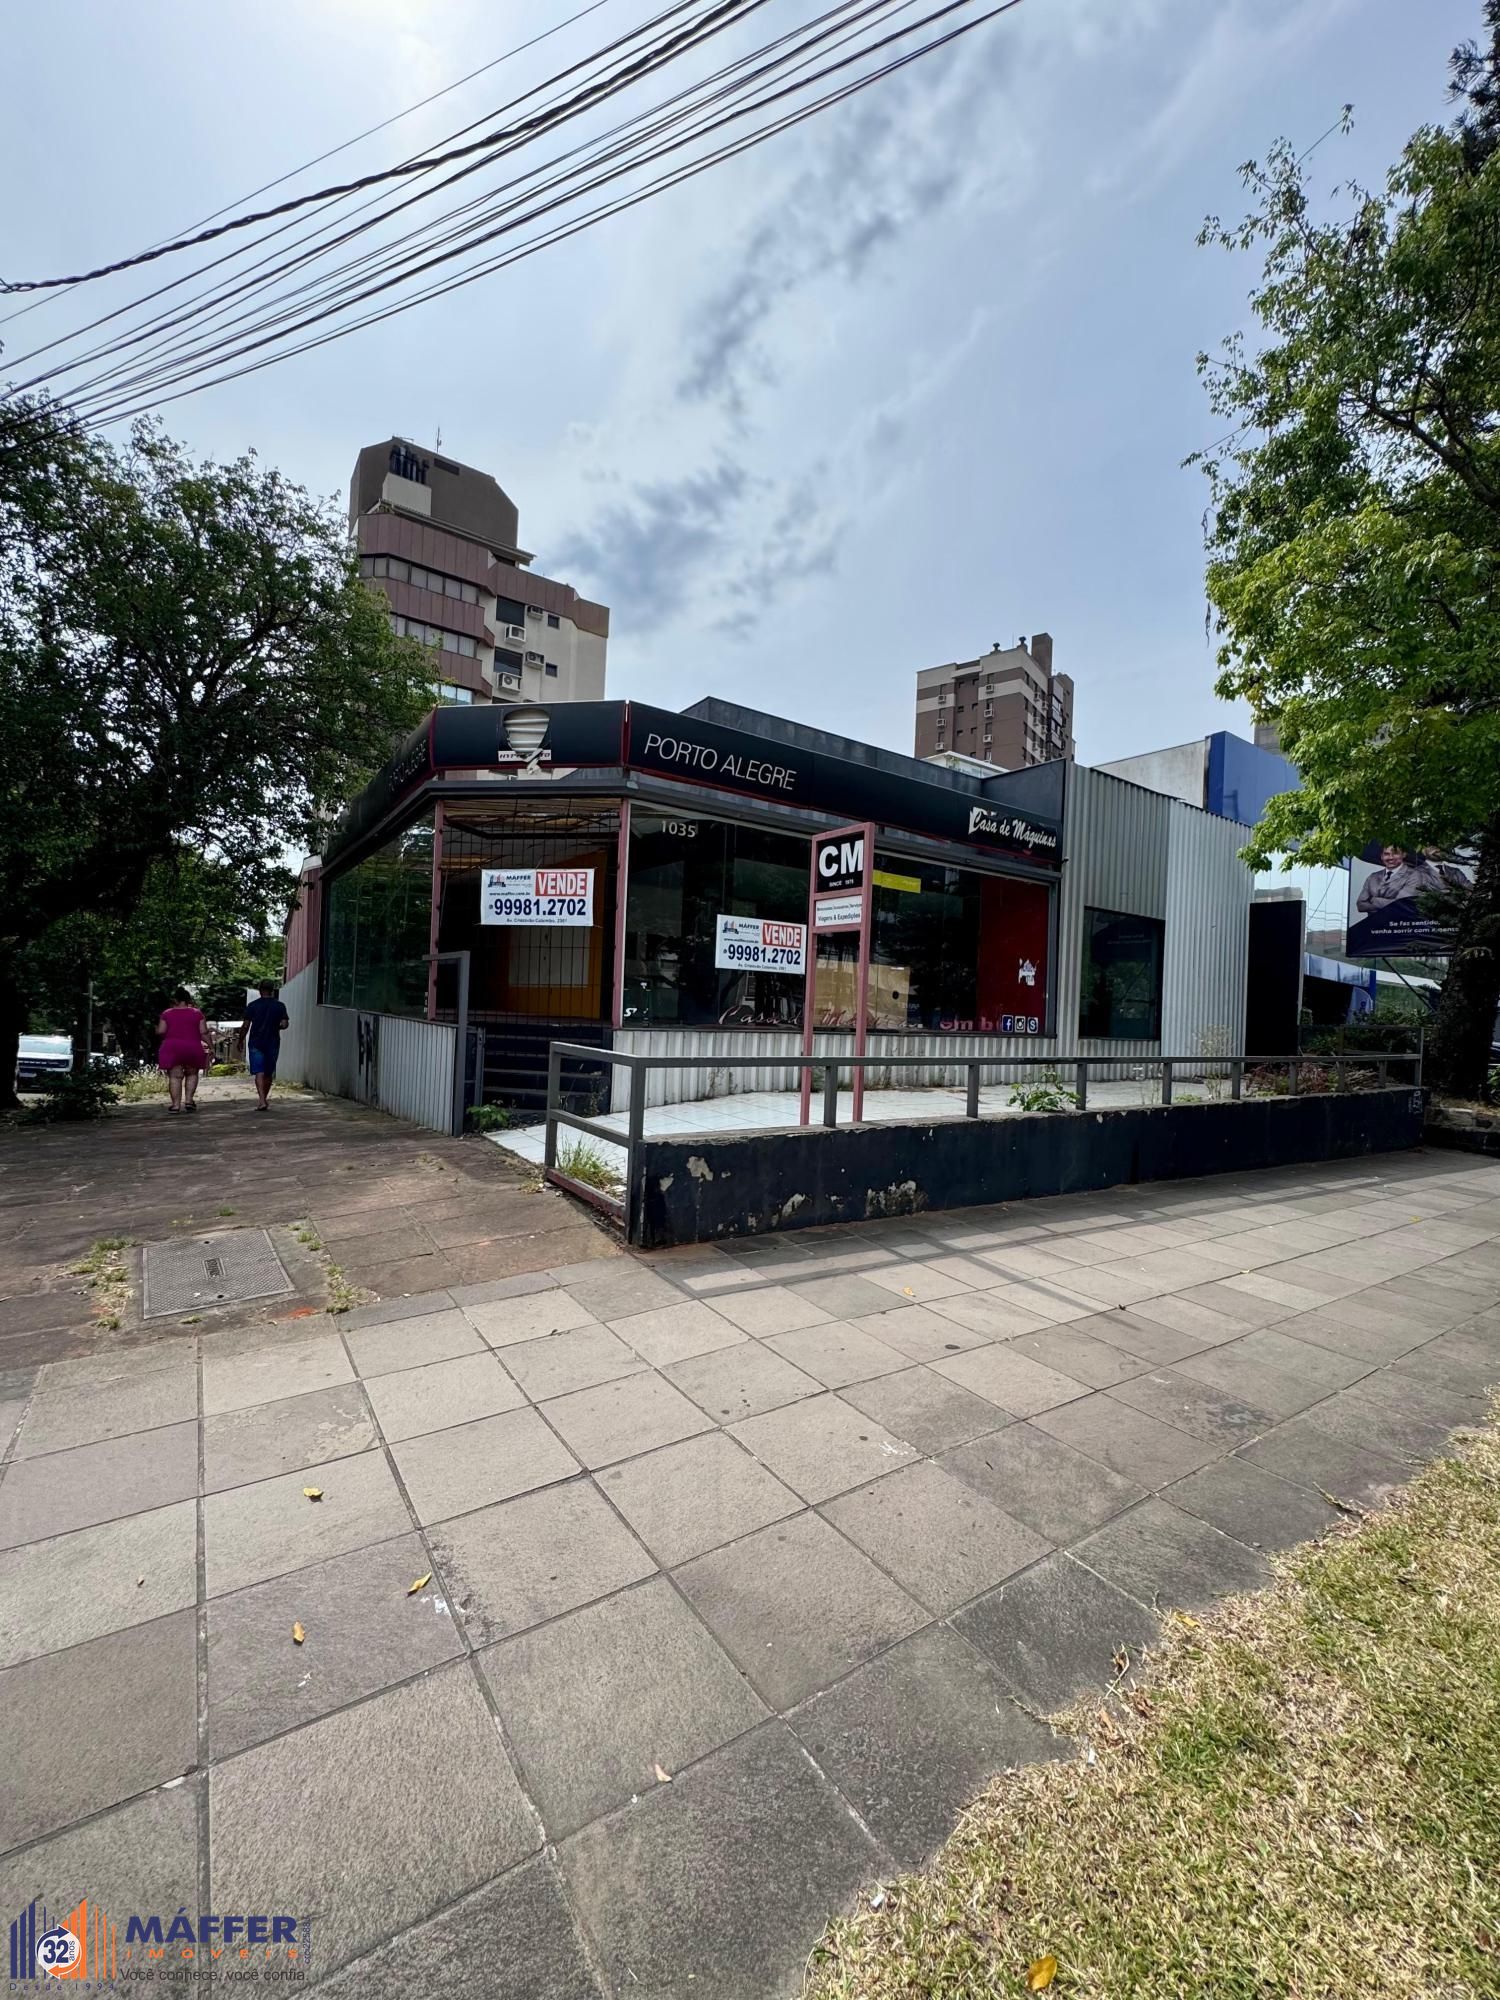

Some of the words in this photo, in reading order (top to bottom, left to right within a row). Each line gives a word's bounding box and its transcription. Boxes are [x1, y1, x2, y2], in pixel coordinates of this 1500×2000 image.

[644, 733, 718, 770] PORTO
[720, 754, 797, 791] ALEGRE
[661, 820, 696, 838] 1035
[1000, 819, 1010, 836] de
[819, 840, 864, 877] CM
[537, 873, 586, 895] VENDE
[494, 898, 586, 916] 99981.2702
[764, 925, 801, 946] VENDE
[728, 944, 801, 965] 99981.2702
